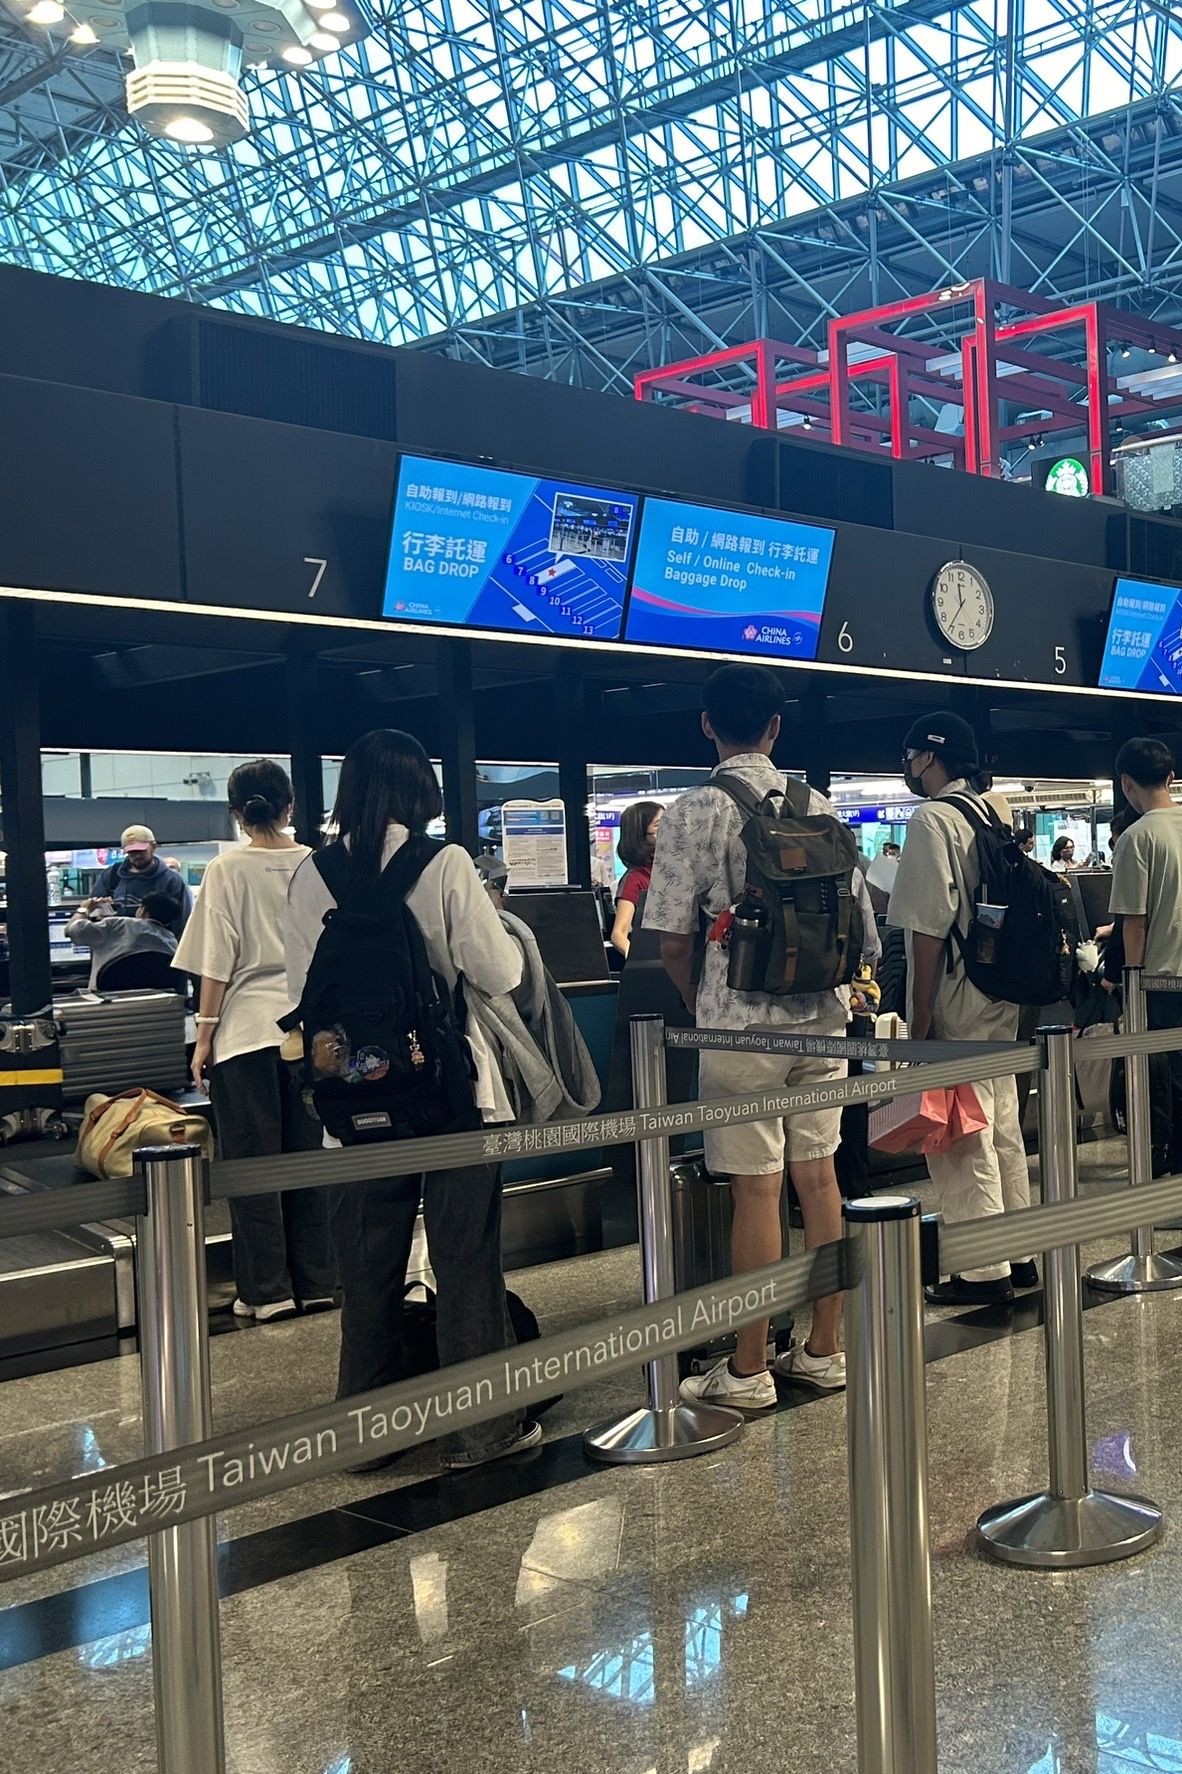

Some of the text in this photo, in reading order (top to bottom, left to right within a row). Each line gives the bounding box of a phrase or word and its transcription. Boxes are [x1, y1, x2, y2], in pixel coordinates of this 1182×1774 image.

[406, 484, 512, 512] 自助報到/網路報到
[404, 501, 471, 520] KIOSK/Internet
[402, 530, 488, 563] 行李託運
[671, 525, 699, 547] 自助
[710, 532, 766, 555] 網路報到
[768, 542, 820, 565] 行李託運
[505, 554, 513, 564] 6
[666, 550, 693, 566] Self
[703, 555, 741, 573] Online
[746, 562, 796, 580] Check-in
[403, 557, 479, 578] BAG DROP
[517, 566, 524, 576] 7
[304, 557, 327, 597] 7
[529, 576, 536, 585] 8
[664, 567, 747, 592] Baggage Drop
[957, 571, 965, 581] 12
[540, 586, 547, 596] 9
[975, 590, 981, 599] 2
[550, 596, 561, 606] 10
[937, 597, 944, 607] 9
[561, 606, 571, 616] 11
[941, 612, 947, 622] 8
[978, 605, 985, 615] 3
[572, 616, 583, 626] 12
[583, 625, 594, 635] 13
[761, 626, 787, 636] CHINA
[837, 621, 853, 653] 6
[755, 634, 791, 645] AIRLINES
[1110, 645, 1147, 659] BAG DROP
[1054, 646, 1066, 674] 5
[680, 1033, 733, 1048] International
[733, 1034, 772, 1050] Taoyuan
[772, 1039, 805, 1053] Taiwan
[482, 1076, 897, 1157] 臺灣桃園國際機場 Taiwan Taoyuan International Airport
[197, 1427, 338, 1493] Taiwan
[347, 1377, 494, 1445] Taoyuan
[504, 1304, 684, 1396] International
[690, 1279, 777, 1331] Airport
